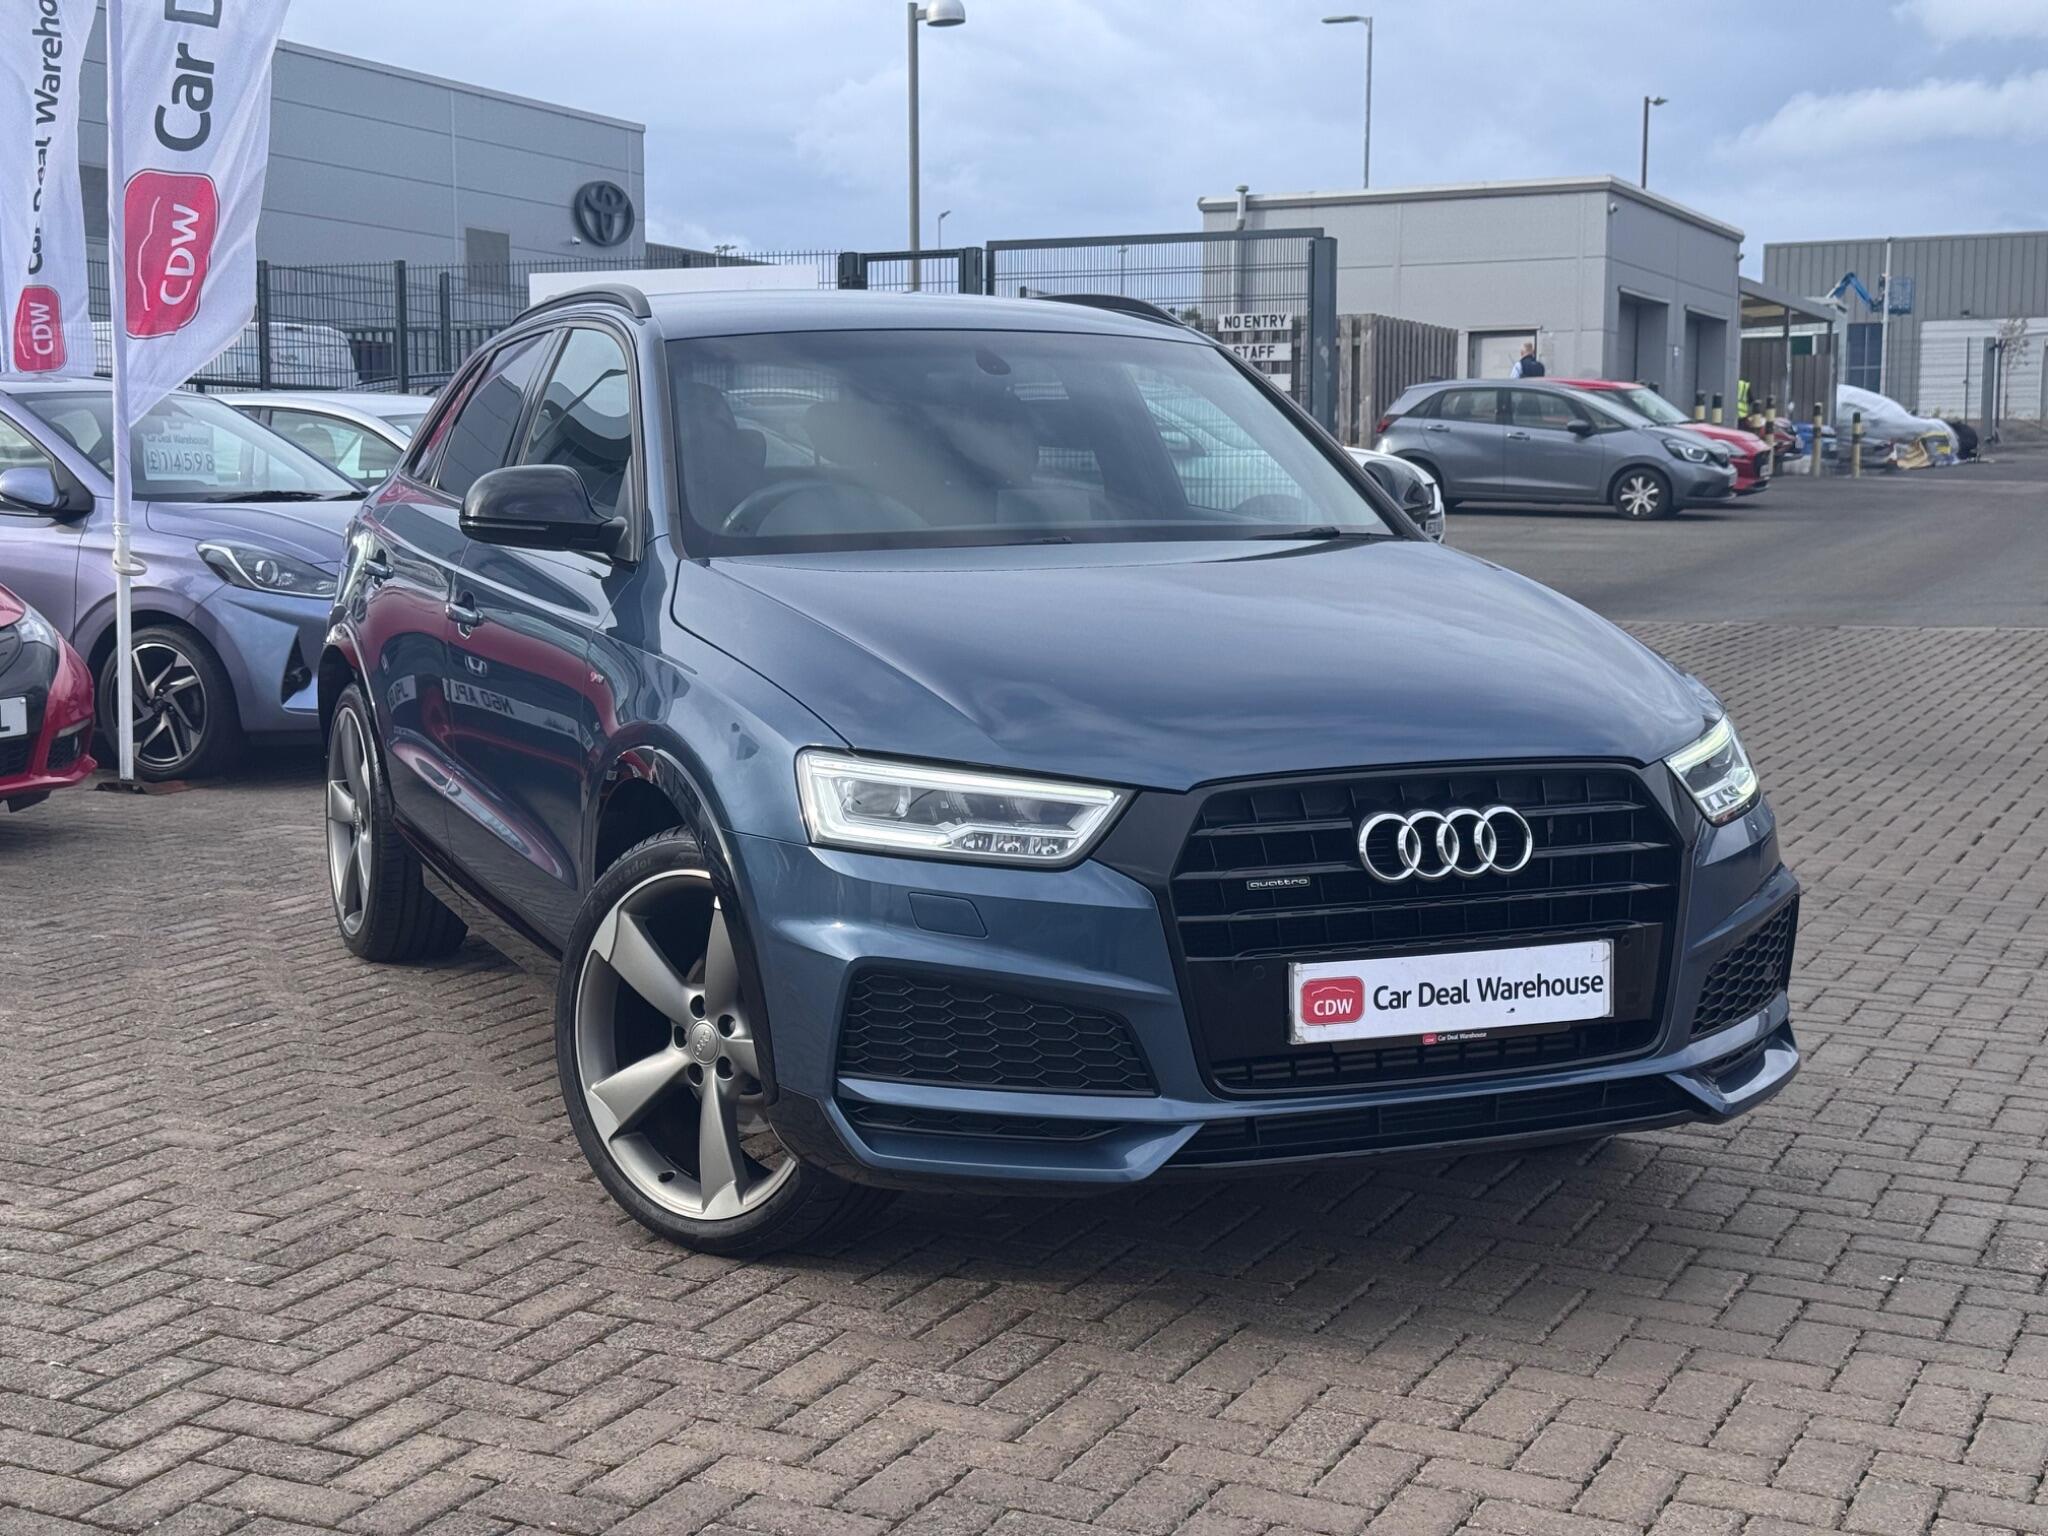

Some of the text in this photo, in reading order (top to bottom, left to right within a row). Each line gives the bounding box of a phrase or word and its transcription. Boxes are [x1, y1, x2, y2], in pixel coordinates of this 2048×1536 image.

[154, 42, 215, 152] Car
[159, 203, 200, 305] CDW
[28, 302, 53, 355] CDW
[1224, 314, 1287, 329] NO ENTRY
[1233, 345, 1275, 359] STAFF
[1249, 878, 1308, 888] quattro
[1373, 973, 1604, 1011] Car Deal Warehouse
[1313, 998, 1353, 1016] CDW
